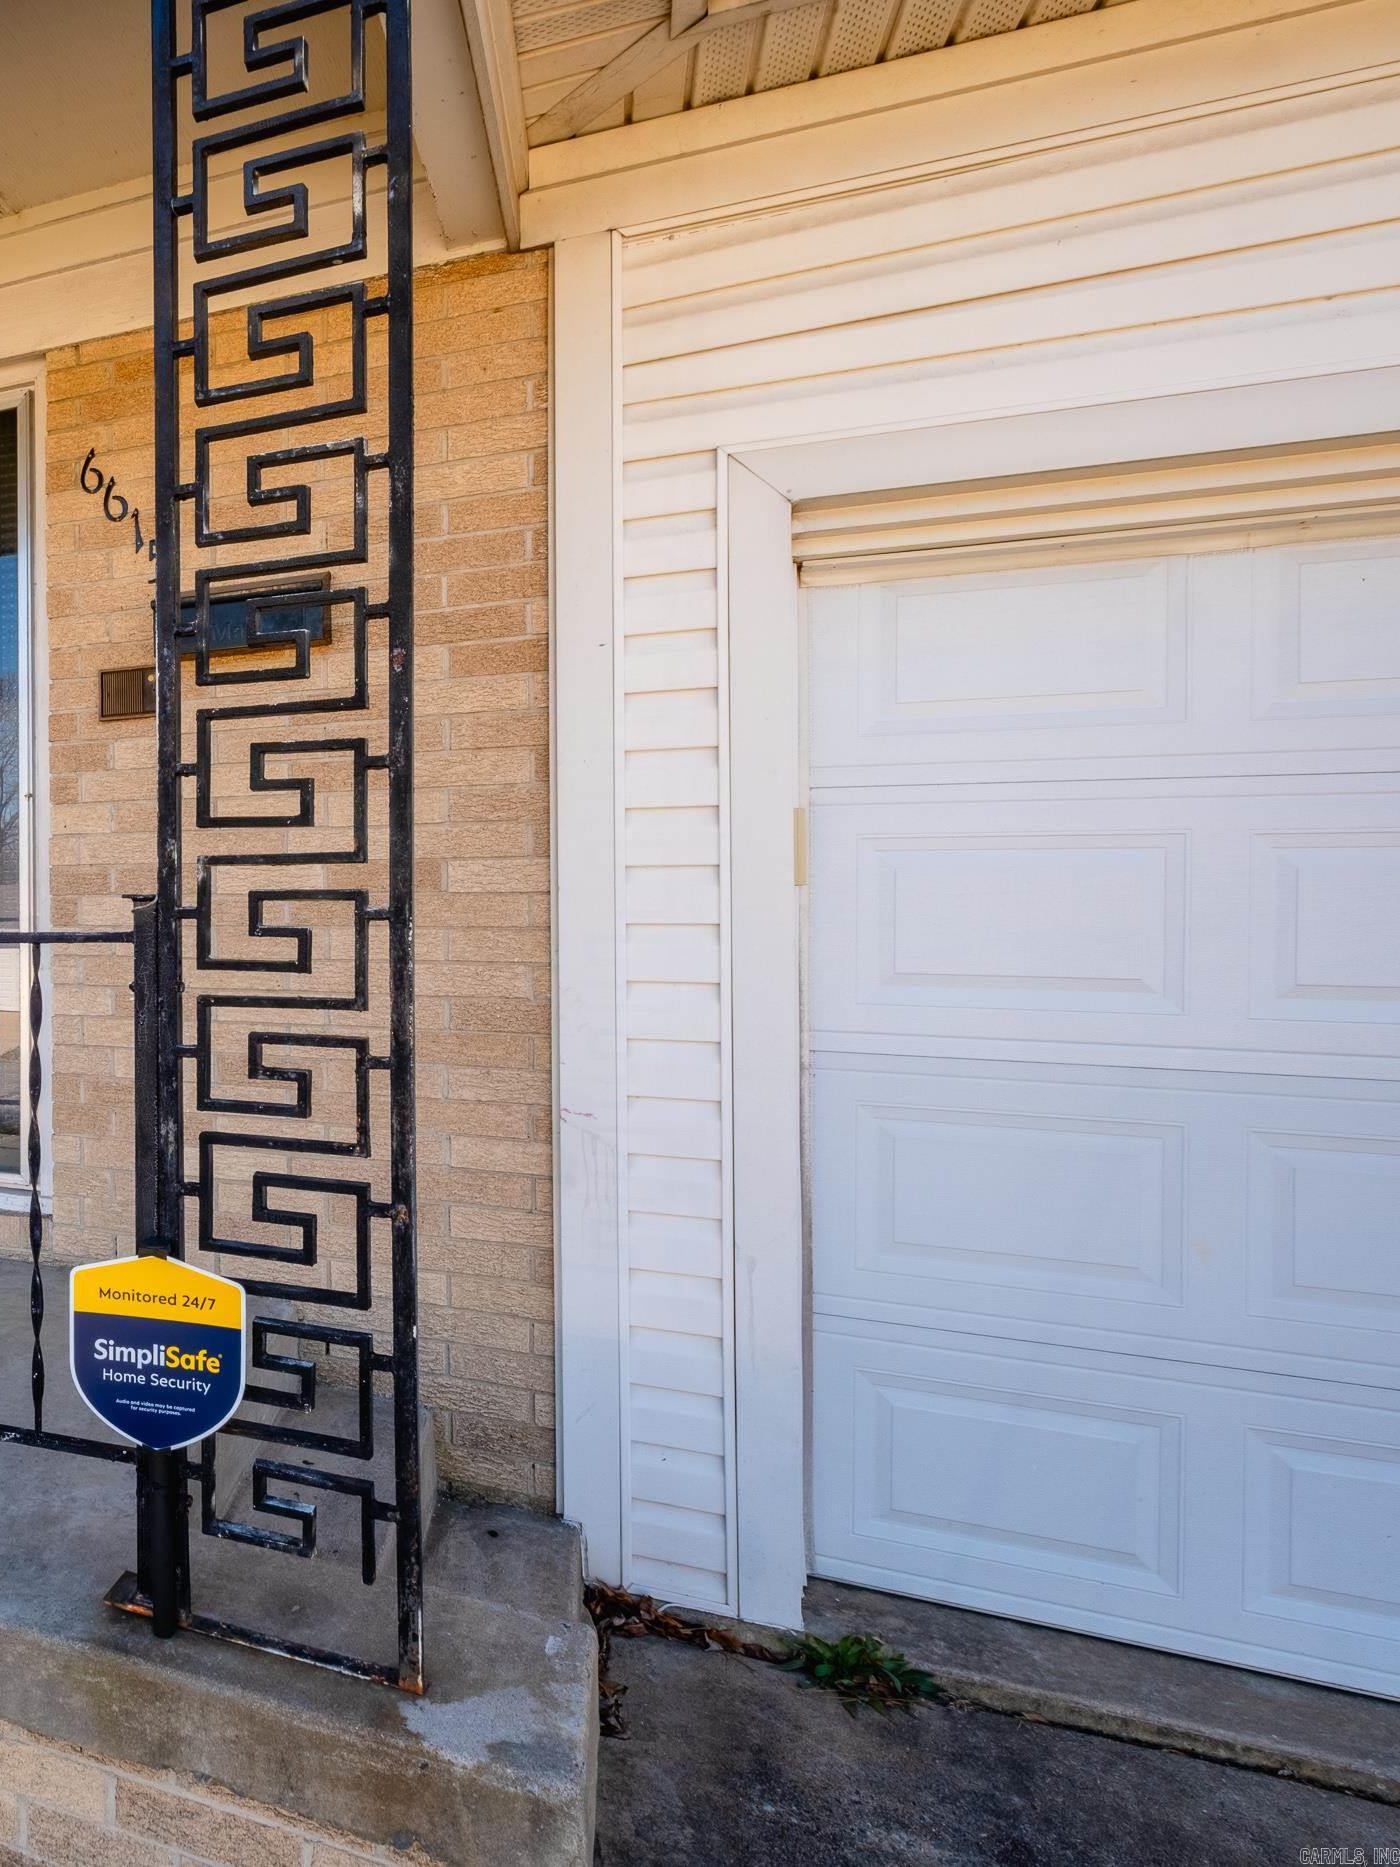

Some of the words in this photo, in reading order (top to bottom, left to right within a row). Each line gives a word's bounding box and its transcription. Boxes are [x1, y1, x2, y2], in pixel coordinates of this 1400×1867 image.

[80, 447, 156, 584] 661
[99, 1287, 177, 1306] Monitored
[182, 1295, 216, 1311] 24/7
[94, 1338, 221, 1374] SimpliSafe
[102, 1368, 146, 1385] Home
[150, 1374, 211, 1396] Security
